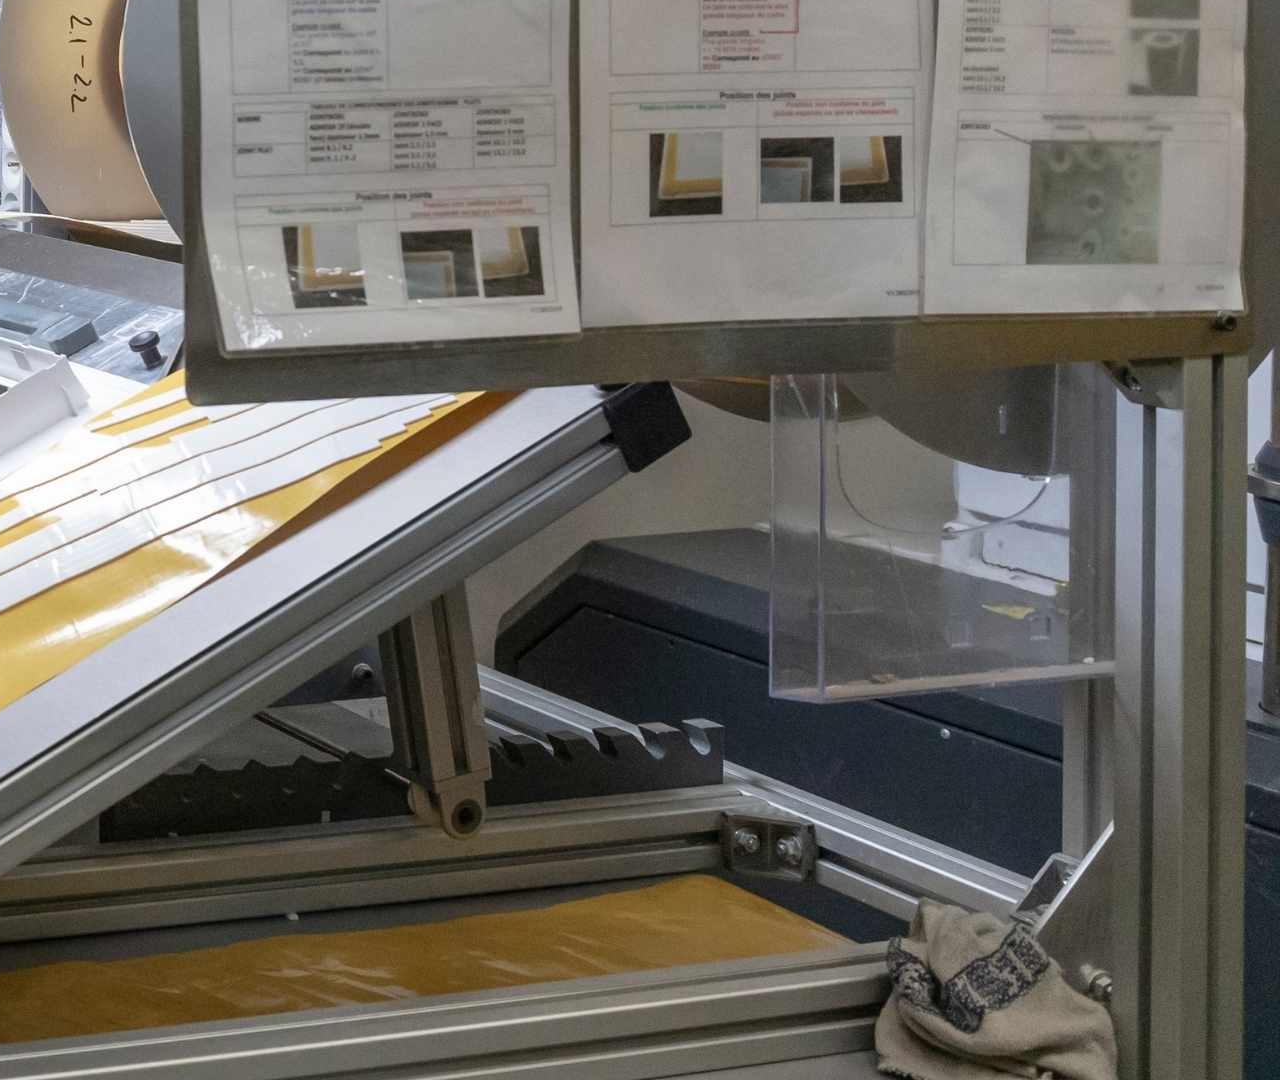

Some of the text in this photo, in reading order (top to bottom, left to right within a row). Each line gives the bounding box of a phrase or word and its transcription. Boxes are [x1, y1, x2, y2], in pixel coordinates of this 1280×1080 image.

[720, 90, 796, 102] Position des joints
[356, 191, 433, 203] Position des joints
